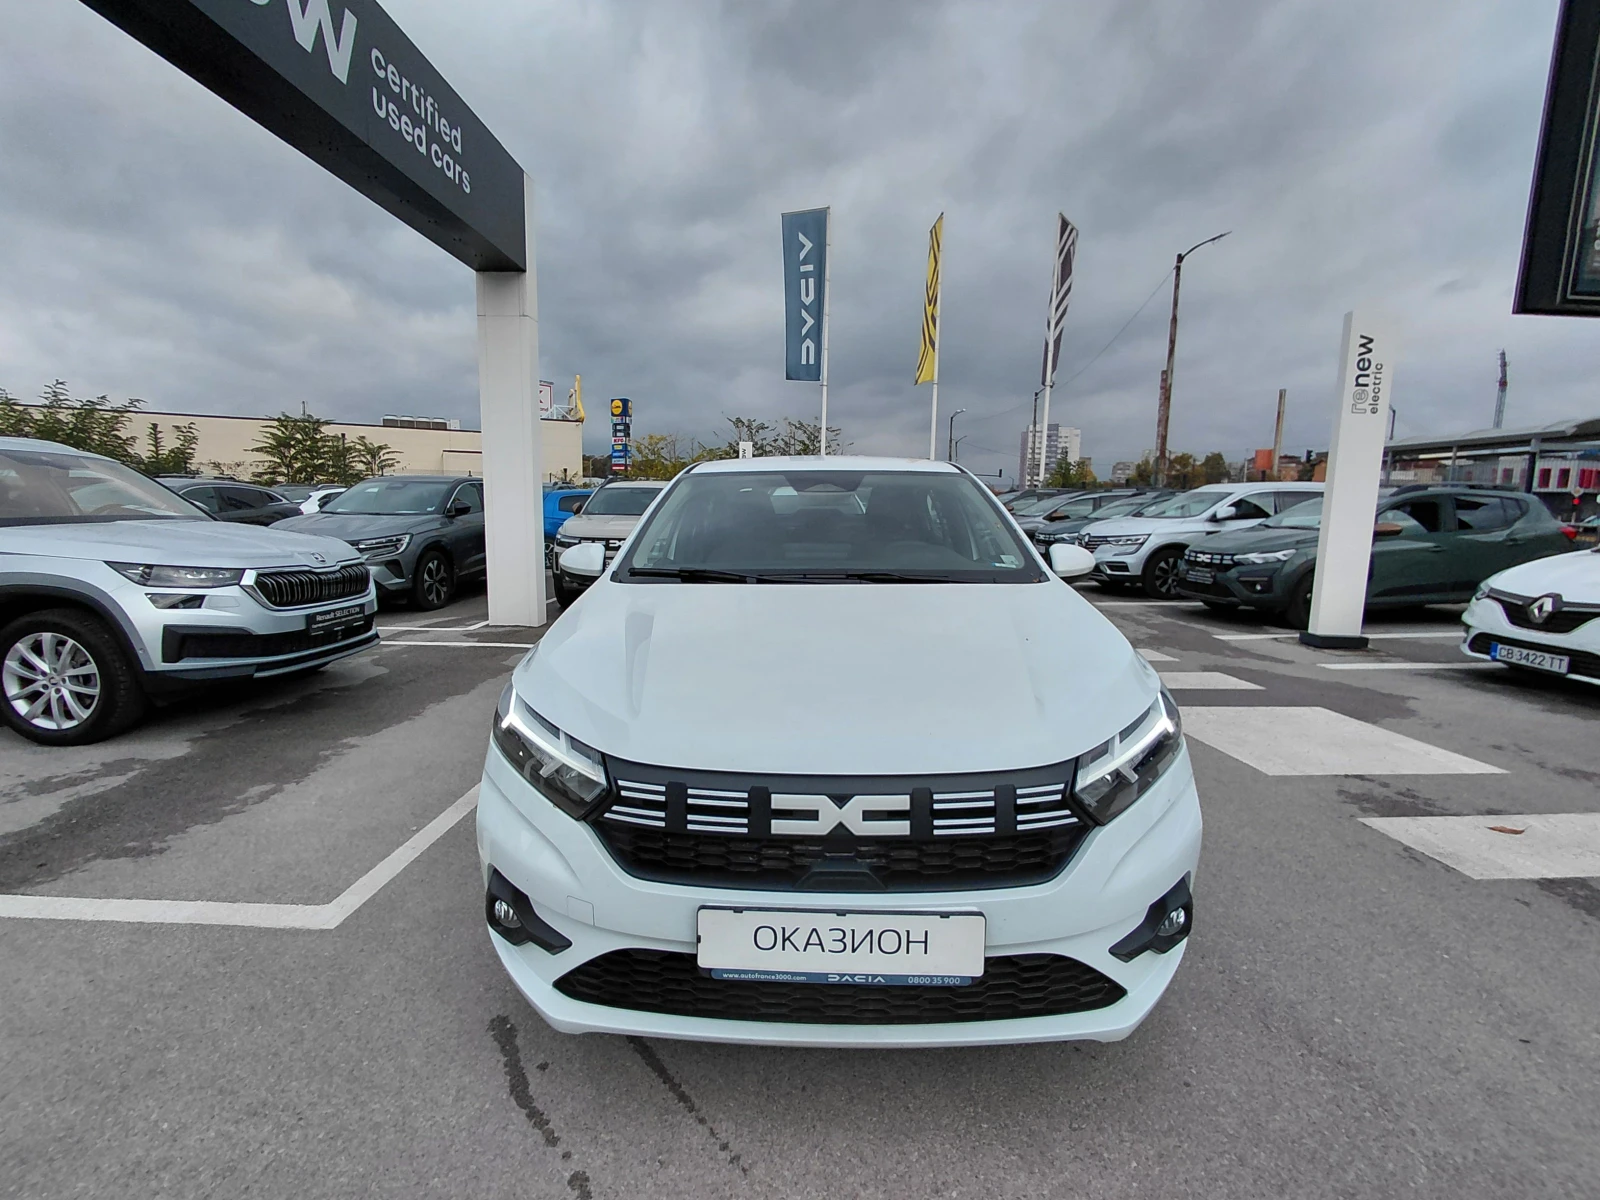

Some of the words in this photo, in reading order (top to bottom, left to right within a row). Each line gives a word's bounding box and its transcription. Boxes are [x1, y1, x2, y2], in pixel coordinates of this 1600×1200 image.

[371, 48, 461, 155] certified
[372, 86, 427, 156] used
[431, 143, 470, 194] cars
[1351, 334, 1374, 414] renew
[1368, 362, 1383, 414] electric
[316, 612, 335, 621] Renault
[1499, 647, 1514, 659] CB
[1516, 650, 1546, 666] 3422
[1549, 656, 1565, 669] TT
[753, 925, 929, 955] ОКАЗИОН
[722, 973, 807, 981] www.autofrance3000.com
[828, 974, 886, 983] DACIA
[908, 976, 931, 984] 0800
